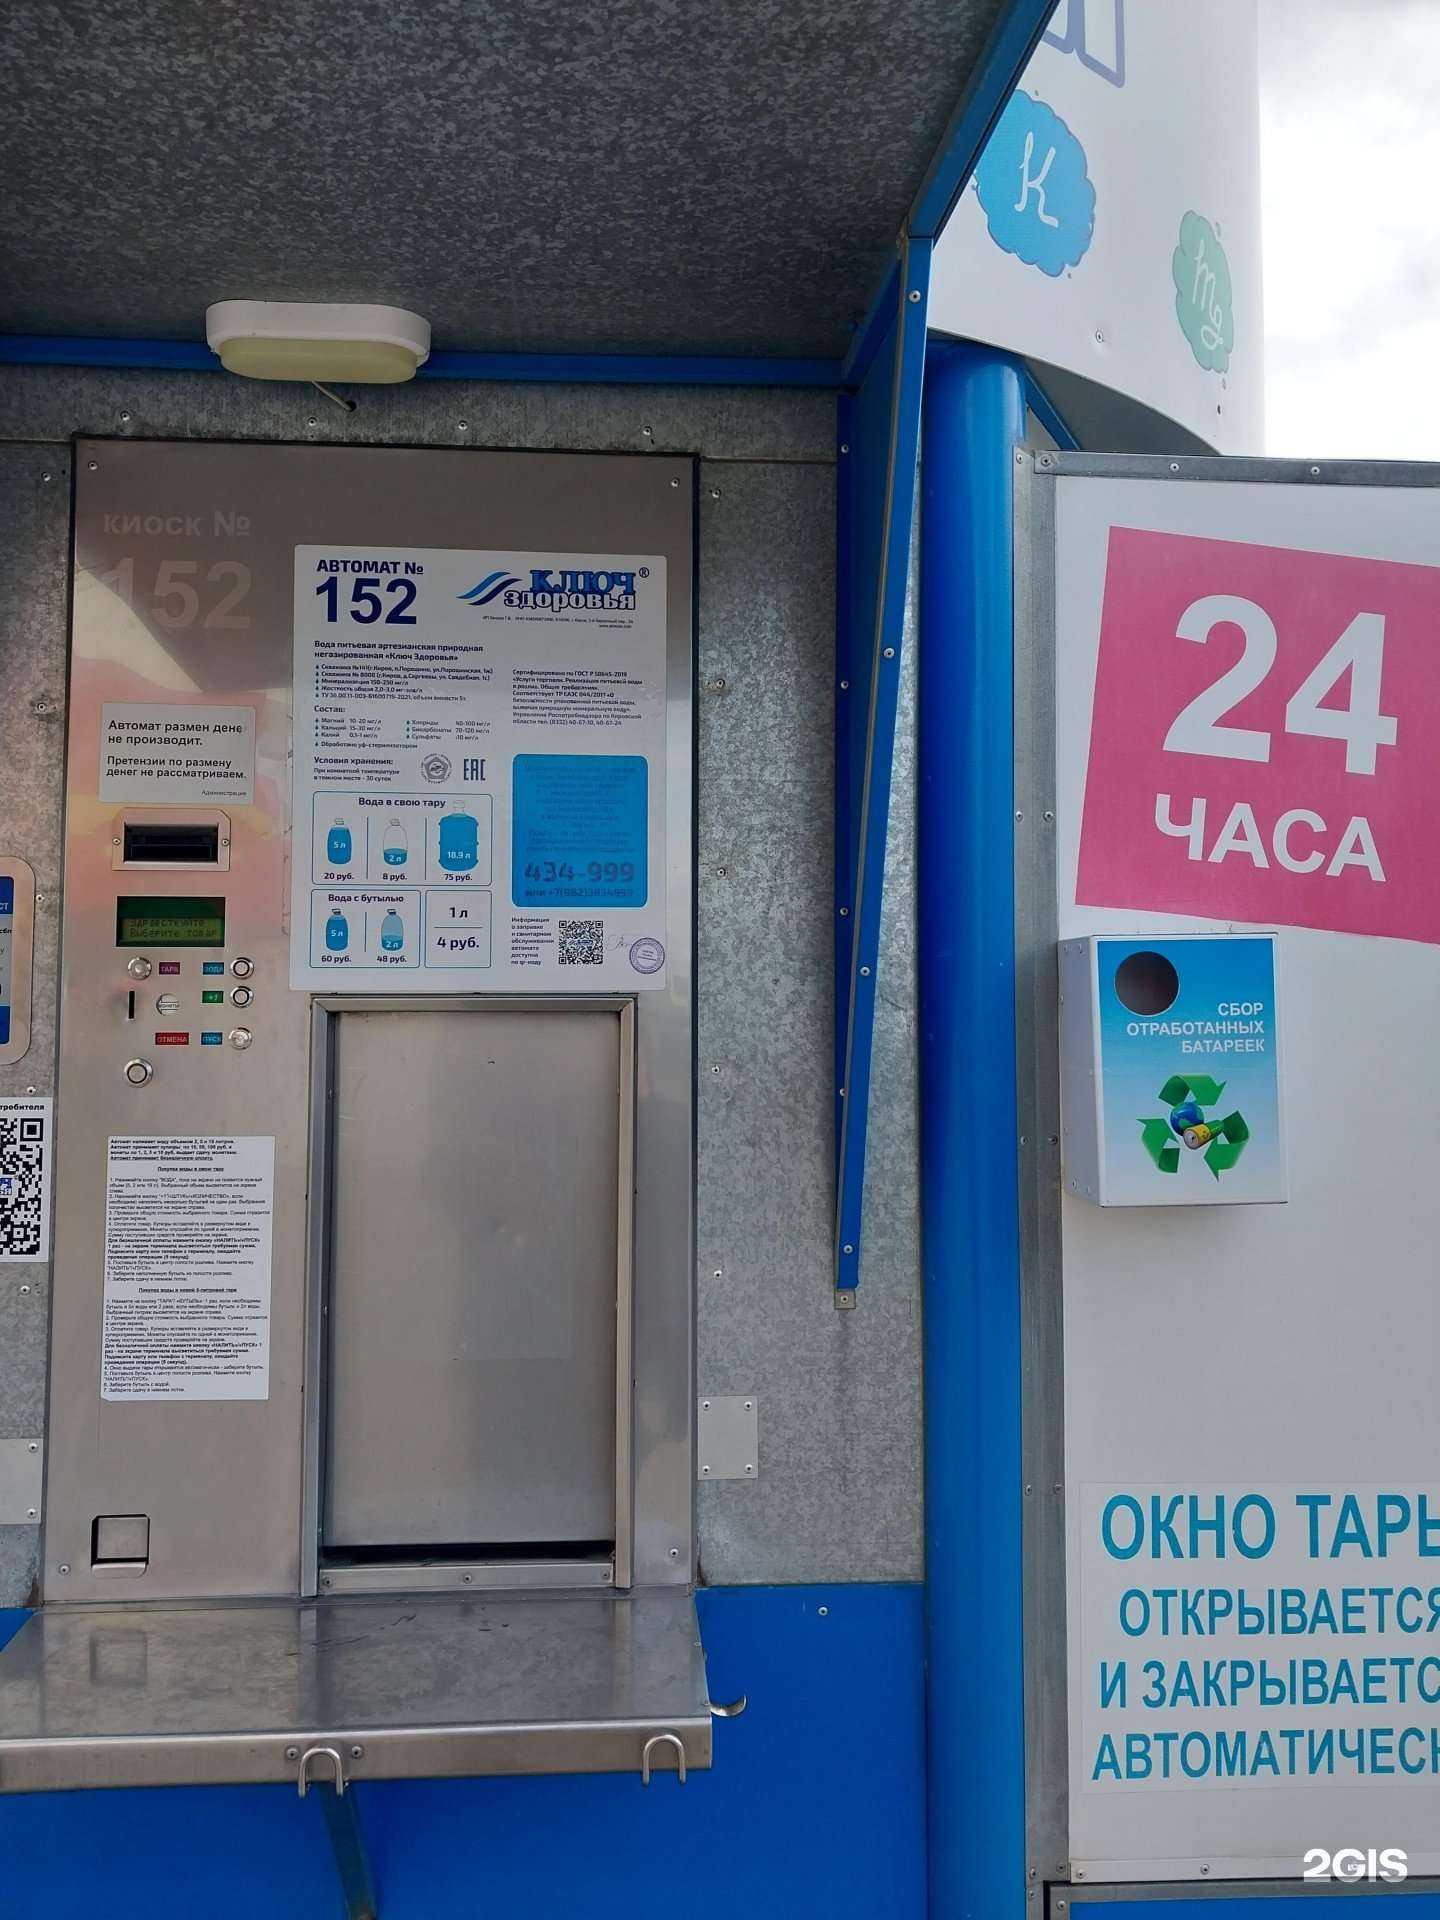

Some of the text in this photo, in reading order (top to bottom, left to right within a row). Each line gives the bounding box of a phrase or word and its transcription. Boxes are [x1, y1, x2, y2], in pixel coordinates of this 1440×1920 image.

[317, 559, 424, 575] АВТОМАТ №
[529, 569, 636, 594] КЛЮЧ
[316, 576, 417, 625] 152
[314, 640, 484, 652] Вода питьевая артезианская природная
[314, 652, 458, 662] негазированная «Ключ Здоровья»
[1162, 593, 1399, 777] 24
[108, 720, 161, 731] Автомат
[165, 722, 210, 733] размен
[108, 736, 203, 746] не производит.
[107, 756, 166, 766] Претензии
[185, 759, 231, 769] размену
[314, 756, 394, 766] Условия хранения:
[106, 768, 137, 777] денег
[156, 770, 247, 779] рассматриваем.
[358, 797, 383, 806] Вода
[394, 799, 420, 807] свою
[423, 800, 446, 808] тару
[1154, 792, 1388, 883] ЧАСА
[336, 873, 354, 882] руб.
[389, 873, 408, 882] руб.
[455, 874, 473, 883] руб.
[328, 893, 352, 902] Вода
[361, 893, 404, 903] бутылью
[449, 907, 468, 918] 1 л
[331, 929, 337, 937] 5
[437, 936, 480, 951] 4 руб.
[334, 955, 351, 964] руб.
[390, 955, 407, 964] руб.
[1217, 1002, 1265, 1018] СБОР
[1126, 1018, 1266, 1038] ОТРАБОТАННЫХ
[157, 1036, 188, 1044] ОТМЕНА
[1181, 1038, 1266, 1055] БАТАРЕЕК
[1101, 1493, 1276, 1560] ОКНО
[1100, 1661, 1127, 1709] И
